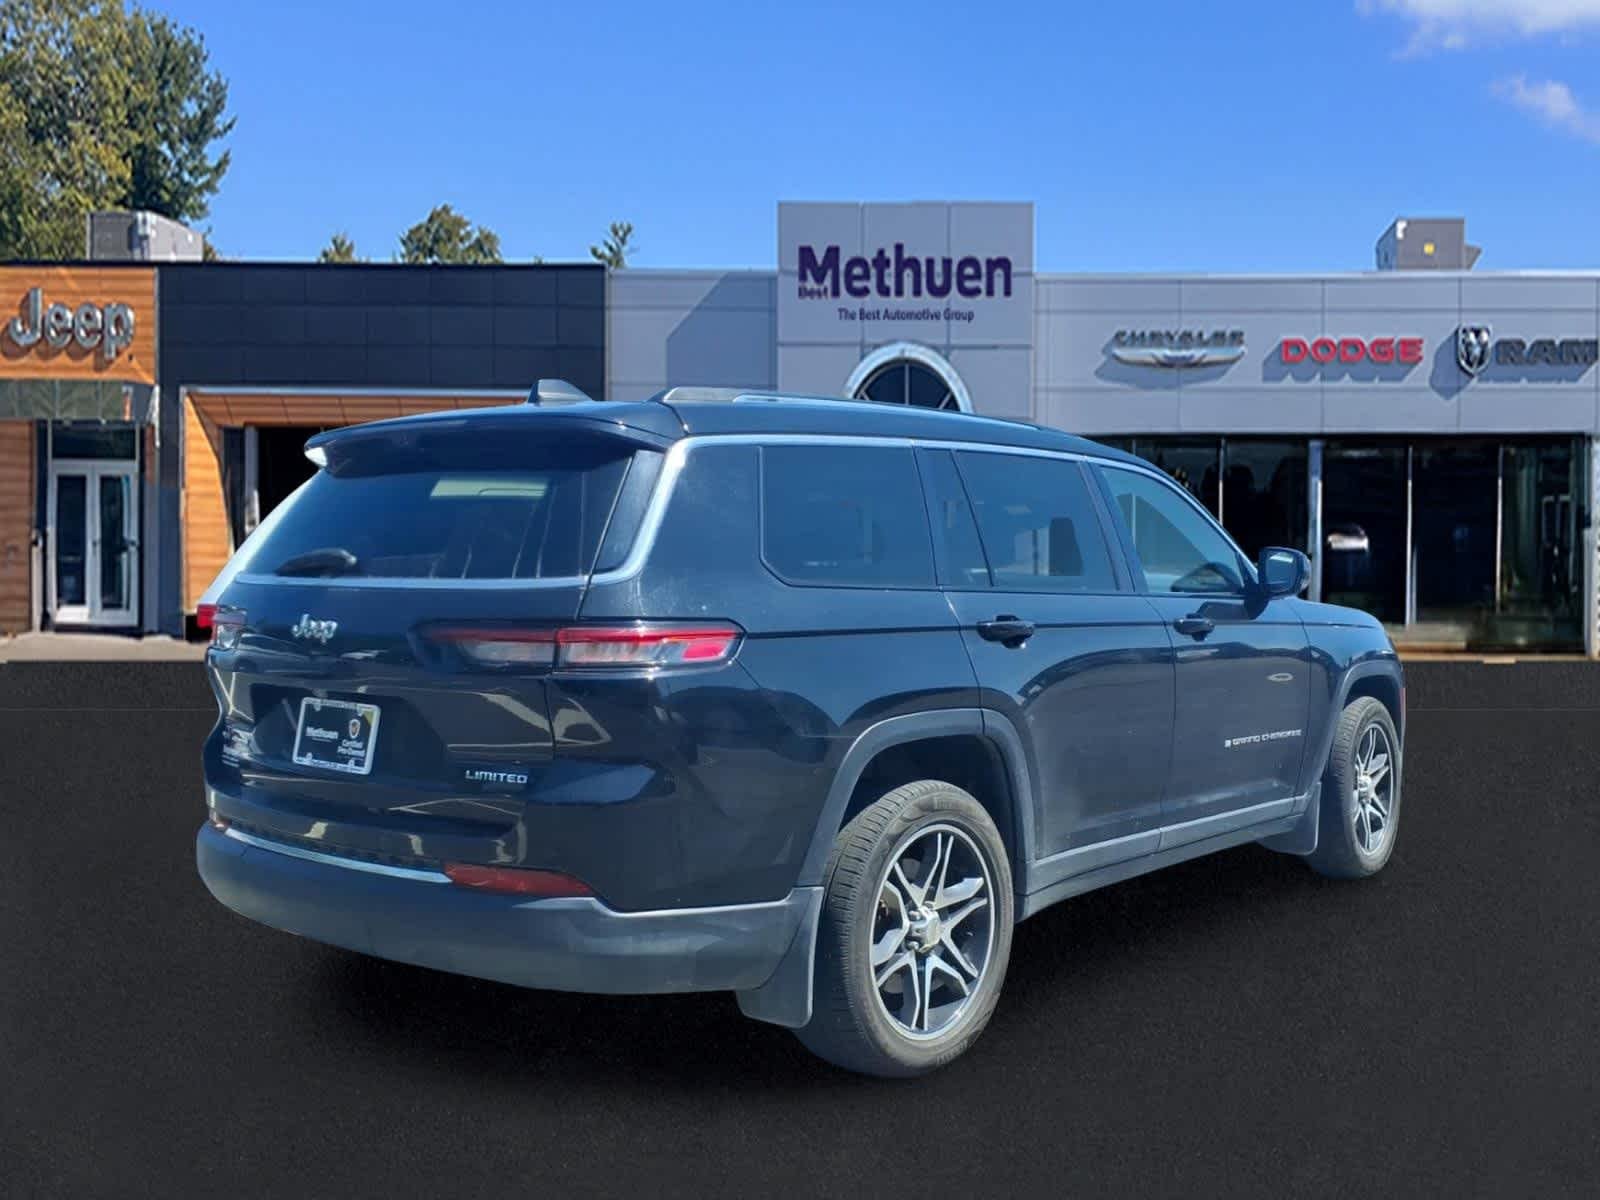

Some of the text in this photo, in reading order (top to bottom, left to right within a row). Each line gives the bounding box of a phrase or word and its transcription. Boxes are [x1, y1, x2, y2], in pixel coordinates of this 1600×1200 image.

[798, 243, 1012, 297] Methuen
[9, 288, 134, 359] Jeep
[838, 308, 975, 324] The Best Automotive Group
[1114, 329, 1244, 347] CHRYSLER
[1281, 337, 1425, 363] DODGE
[1495, 338, 1599, 365] RAM
[292, 614, 338, 643] Jeep
[465, 769, 528, 784] LIMITED
